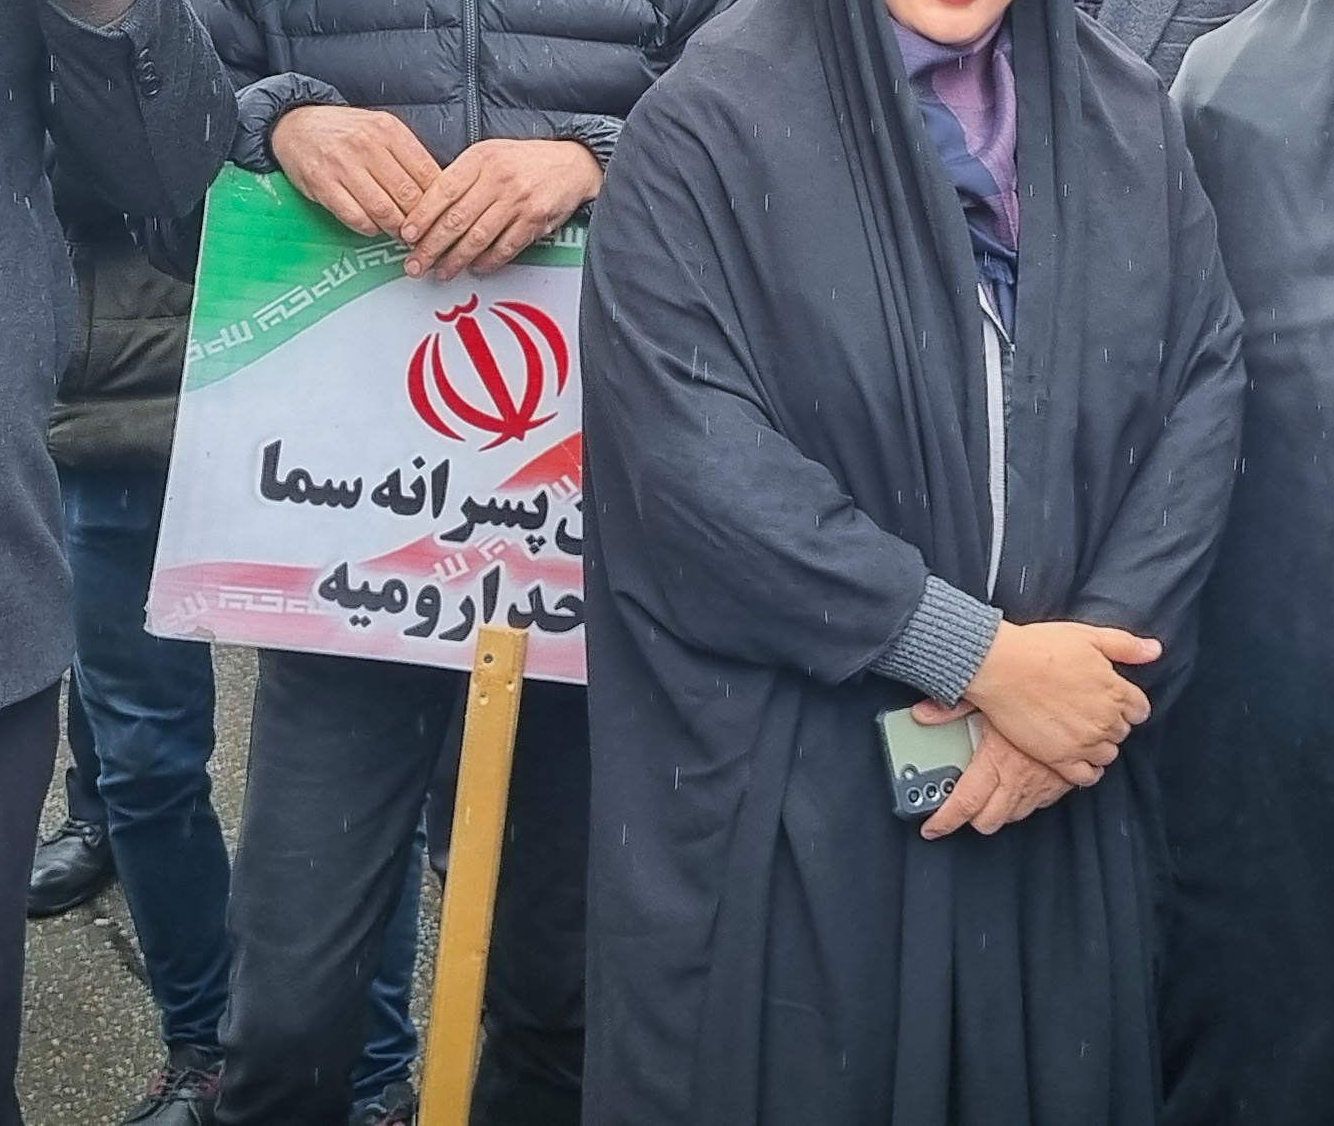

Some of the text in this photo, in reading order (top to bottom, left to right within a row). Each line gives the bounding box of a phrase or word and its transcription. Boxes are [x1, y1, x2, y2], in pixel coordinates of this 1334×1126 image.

[259, 439, 364, 510] سما
[370, 454, 548, 555] پسرانه
[317, 560, 503, 642] ارومیه
